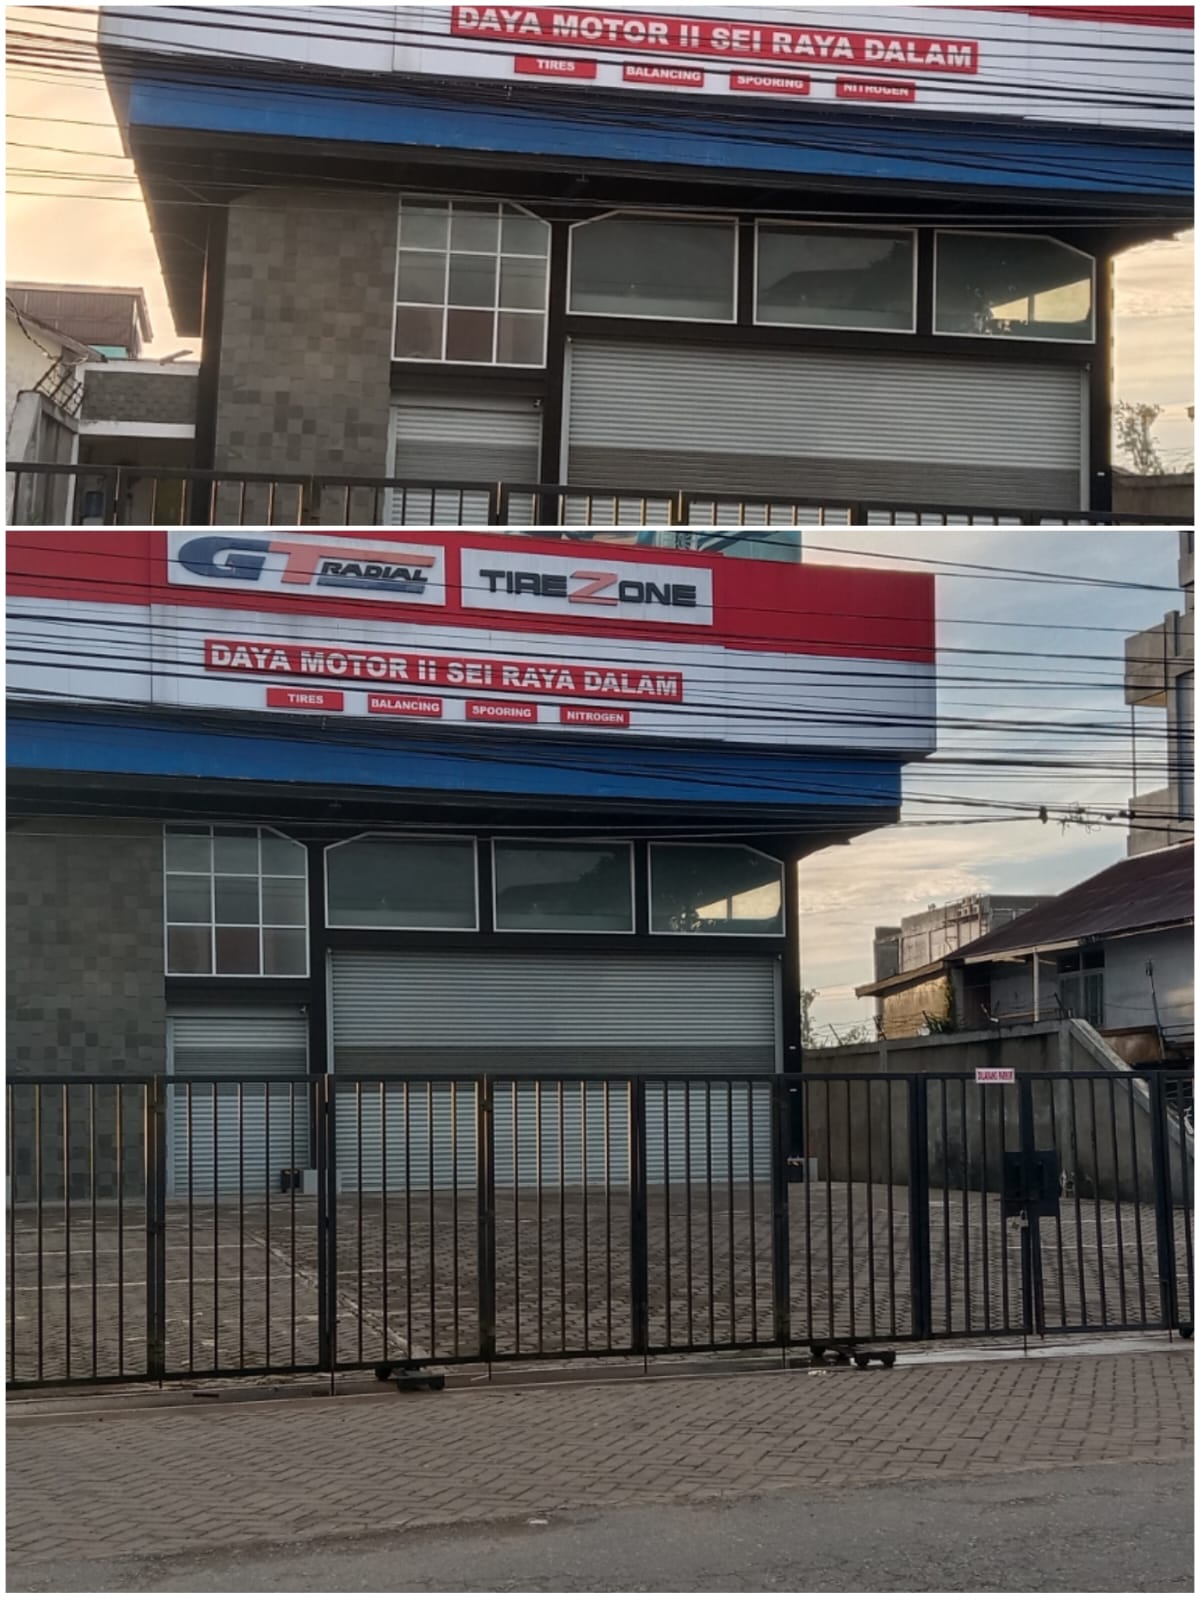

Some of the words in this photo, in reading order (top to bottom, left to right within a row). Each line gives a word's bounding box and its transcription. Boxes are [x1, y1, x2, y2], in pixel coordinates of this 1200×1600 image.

[458, 7, 542, 36] DAYA
[553, 14, 669, 46] MOTOR
[710, 27, 760, 51] SEI
[772, 31, 854, 59] RAYA
[865, 39, 971, 67] DALAM
[536, 59, 575, 71] TIRES
[626, 66, 702, 82] BALANCING
[737, 75, 804, 89] SPOORING
[321, 561, 428, 583] RADIAL
[211, 644, 291, 671] DAYA
[301, 651, 408, 679] MOTOR
[447, 662, 491, 684] SEI
[502, 665, 575, 690] RAYA
[584, 671, 678, 697] DALAM
[287, 693, 324, 704] TIRES
[371, 698, 440, 712] BALANCING
[472, 705, 532, 718] SPOORING
[566, 710, 624, 723] NITROGEN
